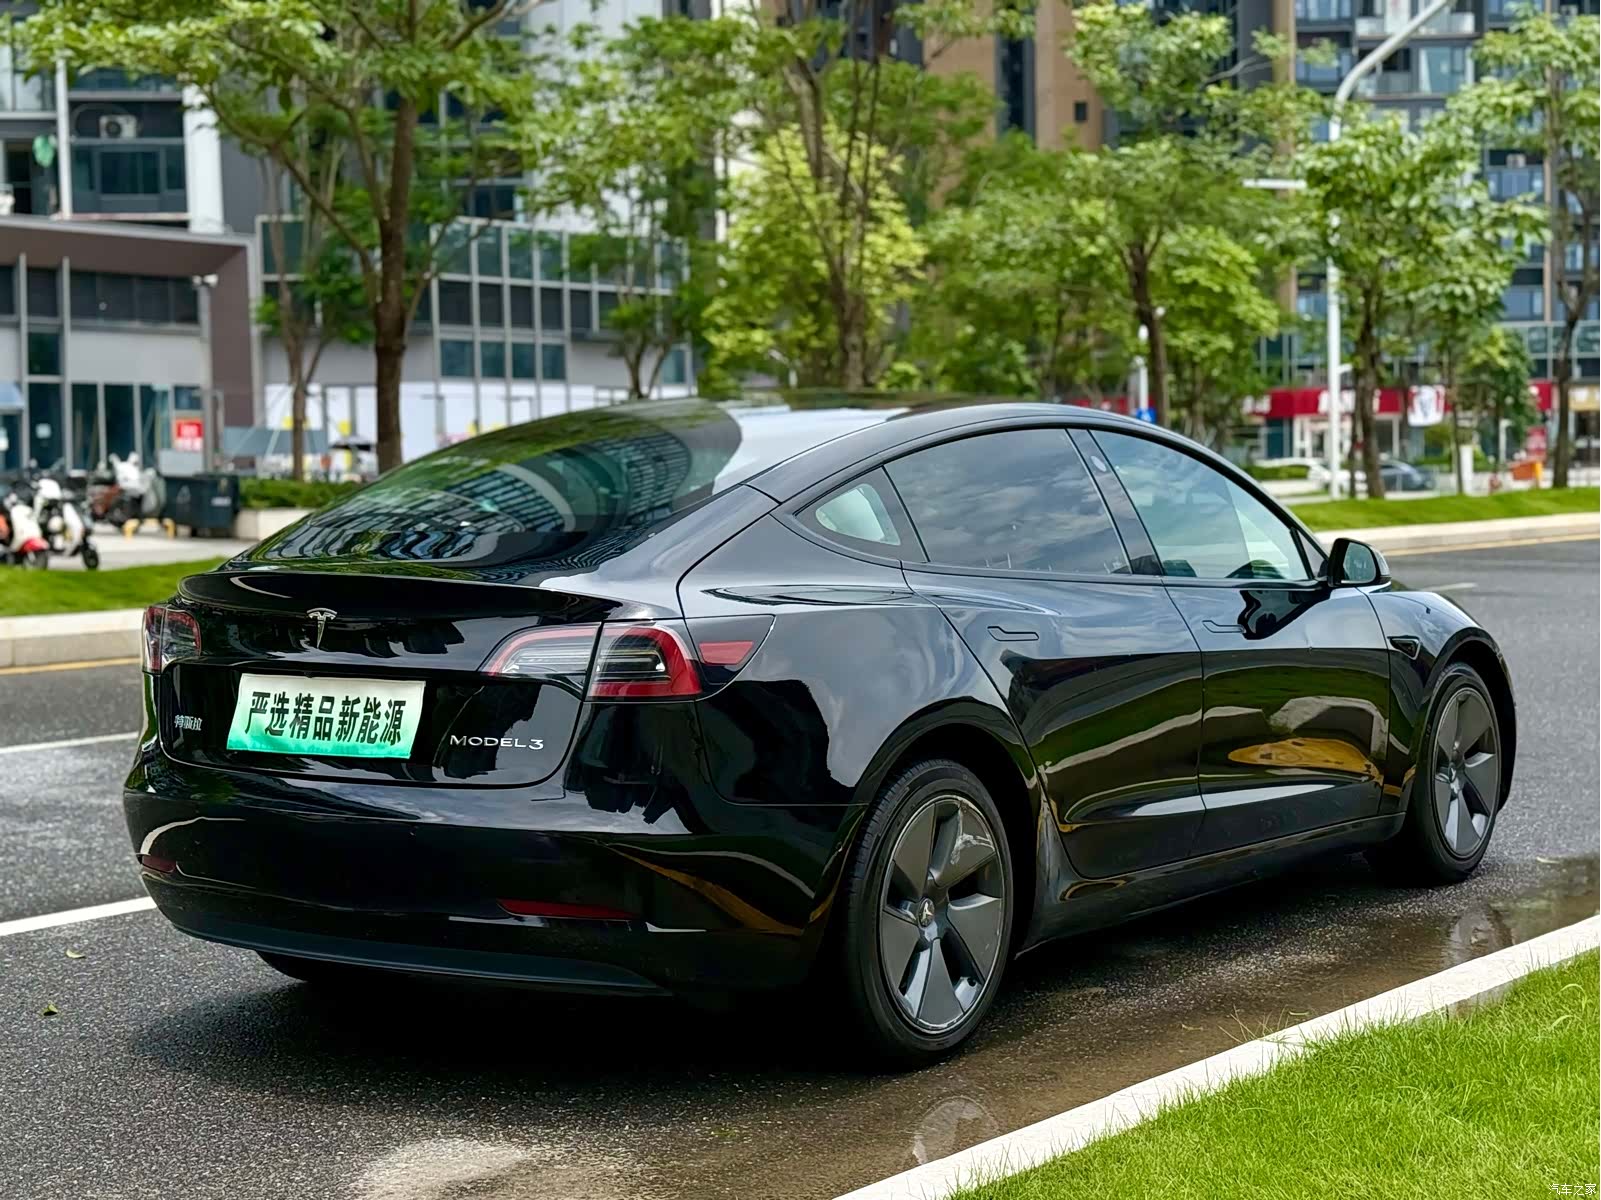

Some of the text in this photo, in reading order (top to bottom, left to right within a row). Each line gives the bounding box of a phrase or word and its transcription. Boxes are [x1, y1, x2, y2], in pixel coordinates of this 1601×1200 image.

[244, 691, 407, 746] 严选精品新能源
[449, 734, 544, 750] MODEL 3
